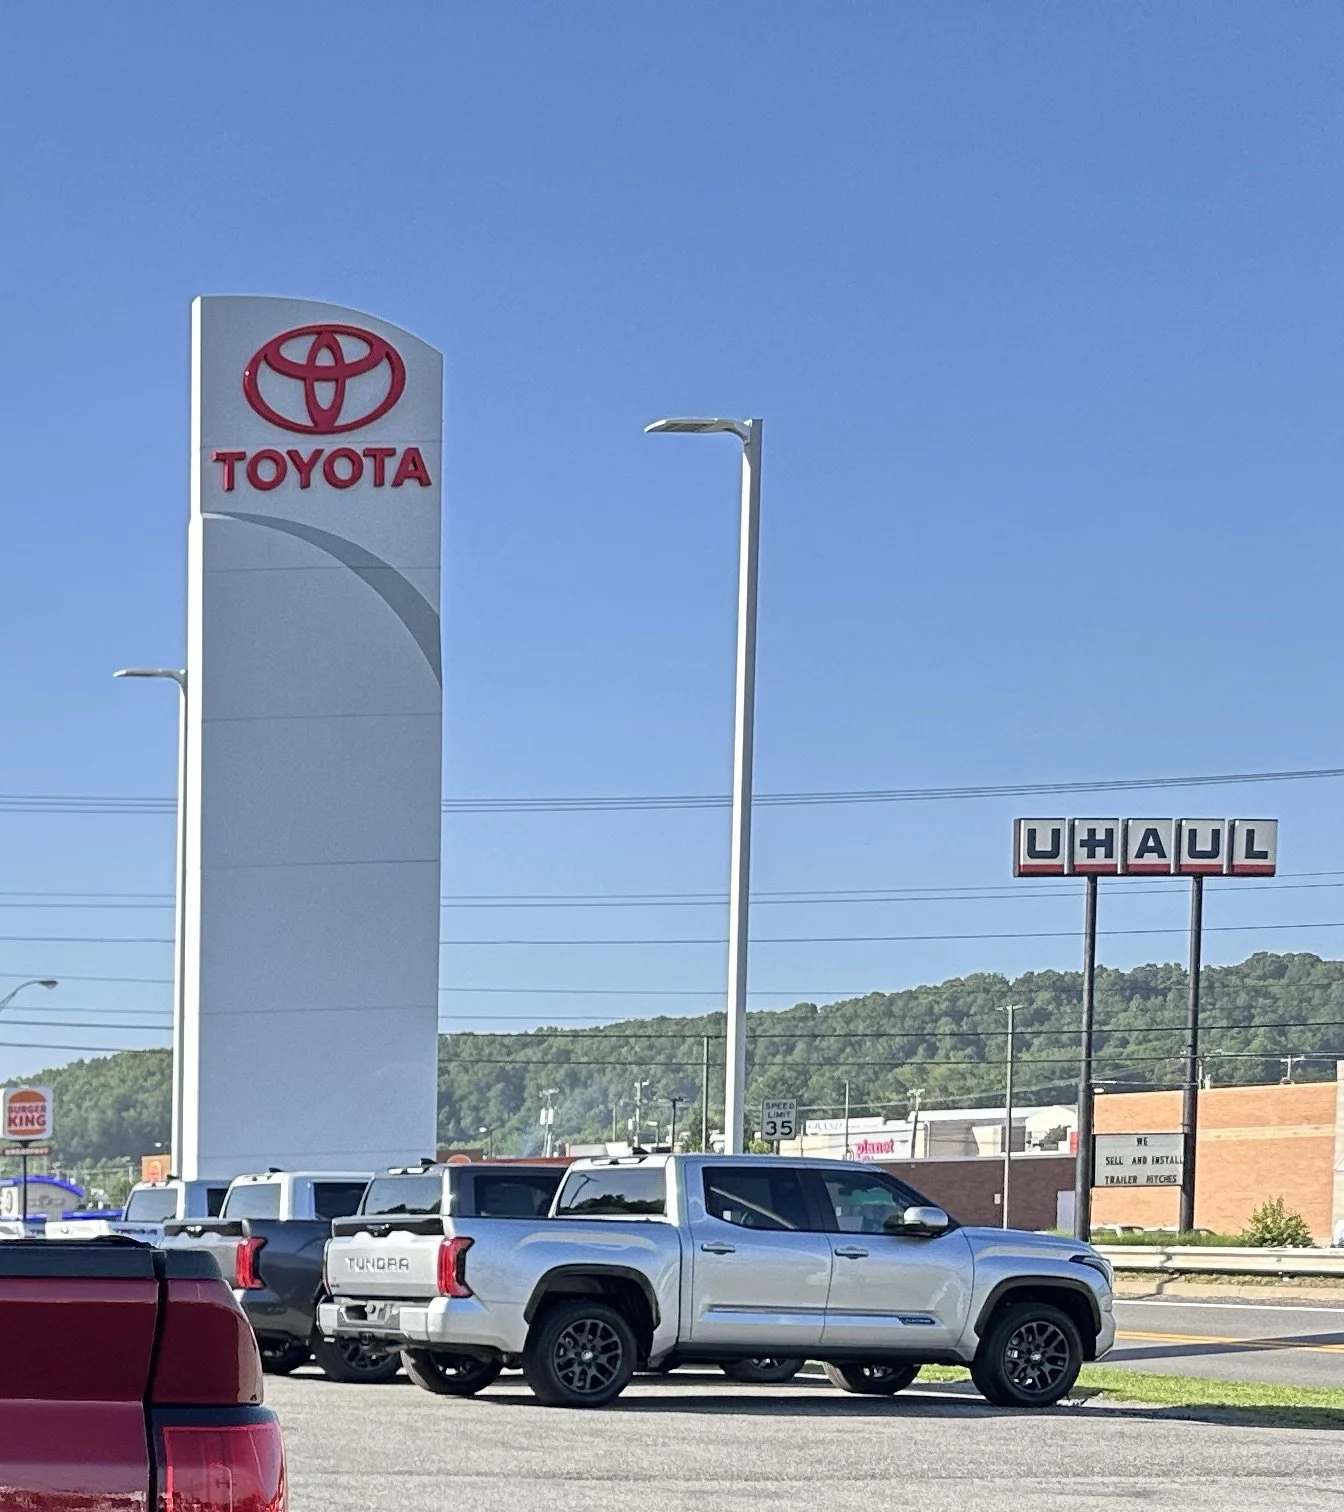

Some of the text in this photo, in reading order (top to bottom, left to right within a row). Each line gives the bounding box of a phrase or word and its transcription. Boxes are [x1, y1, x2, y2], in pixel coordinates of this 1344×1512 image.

[212, 447, 433, 493] TOYOTA
[7, 1104, 47, 1114] BURGER
[765, 1102, 795, 1110] SPEED
[767, 1111, 791, 1119] LIMIT
[7, 1114, 47, 1127] KING
[765, 1120, 793, 1136] 35
[1136, 1137, 1149, 1147] WE
[1105, 1155, 1184, 1166] SELL AND INSTALL
[1104, 1175, 1138, 1185] TRAILER
[345, 1257, 409, 1273] TUNDRA
